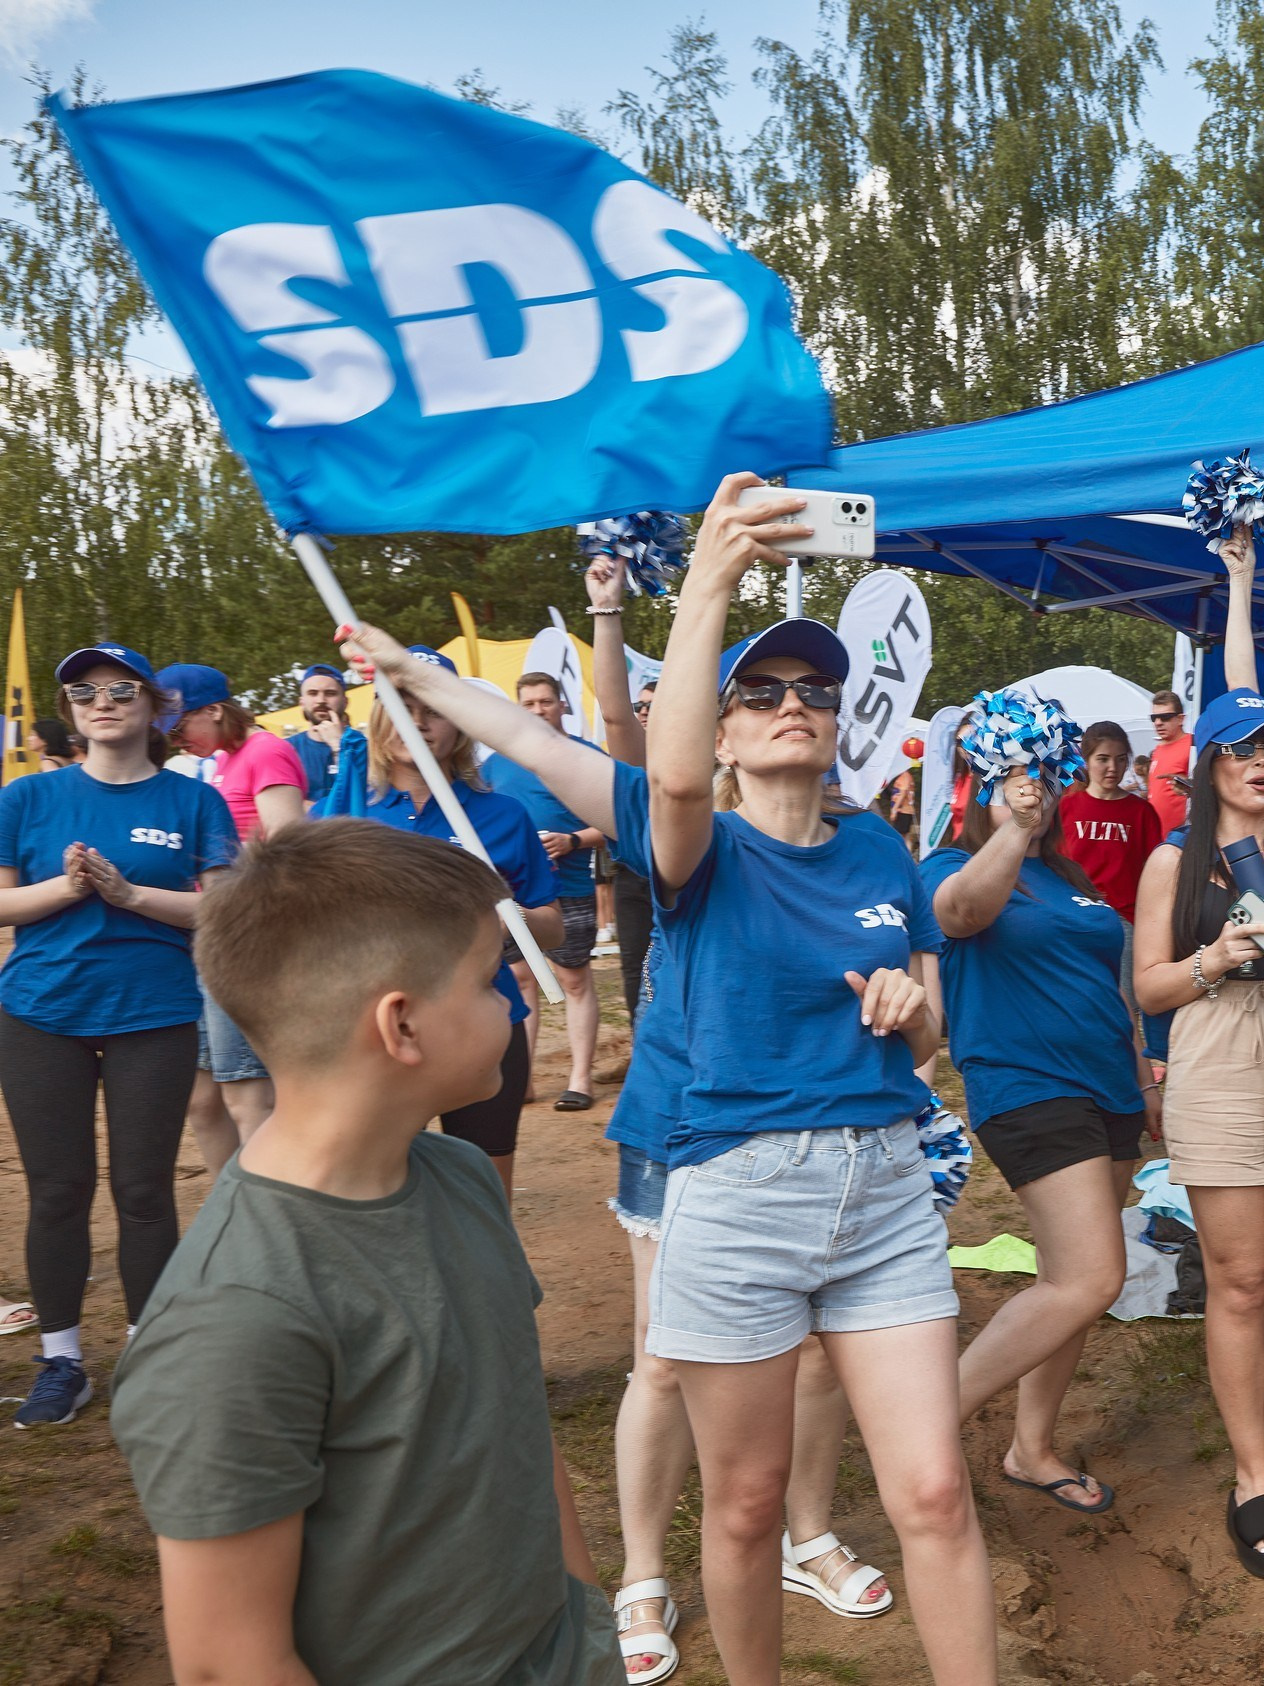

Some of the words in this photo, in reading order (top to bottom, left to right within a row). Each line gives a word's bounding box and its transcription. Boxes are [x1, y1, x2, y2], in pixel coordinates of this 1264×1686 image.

[203, 179, 748, 428] SDS
[408, 652, 441, 665] DS
[130, 827, 184, 850] SDS
[1074, 820, 1132, 843] VLTN
